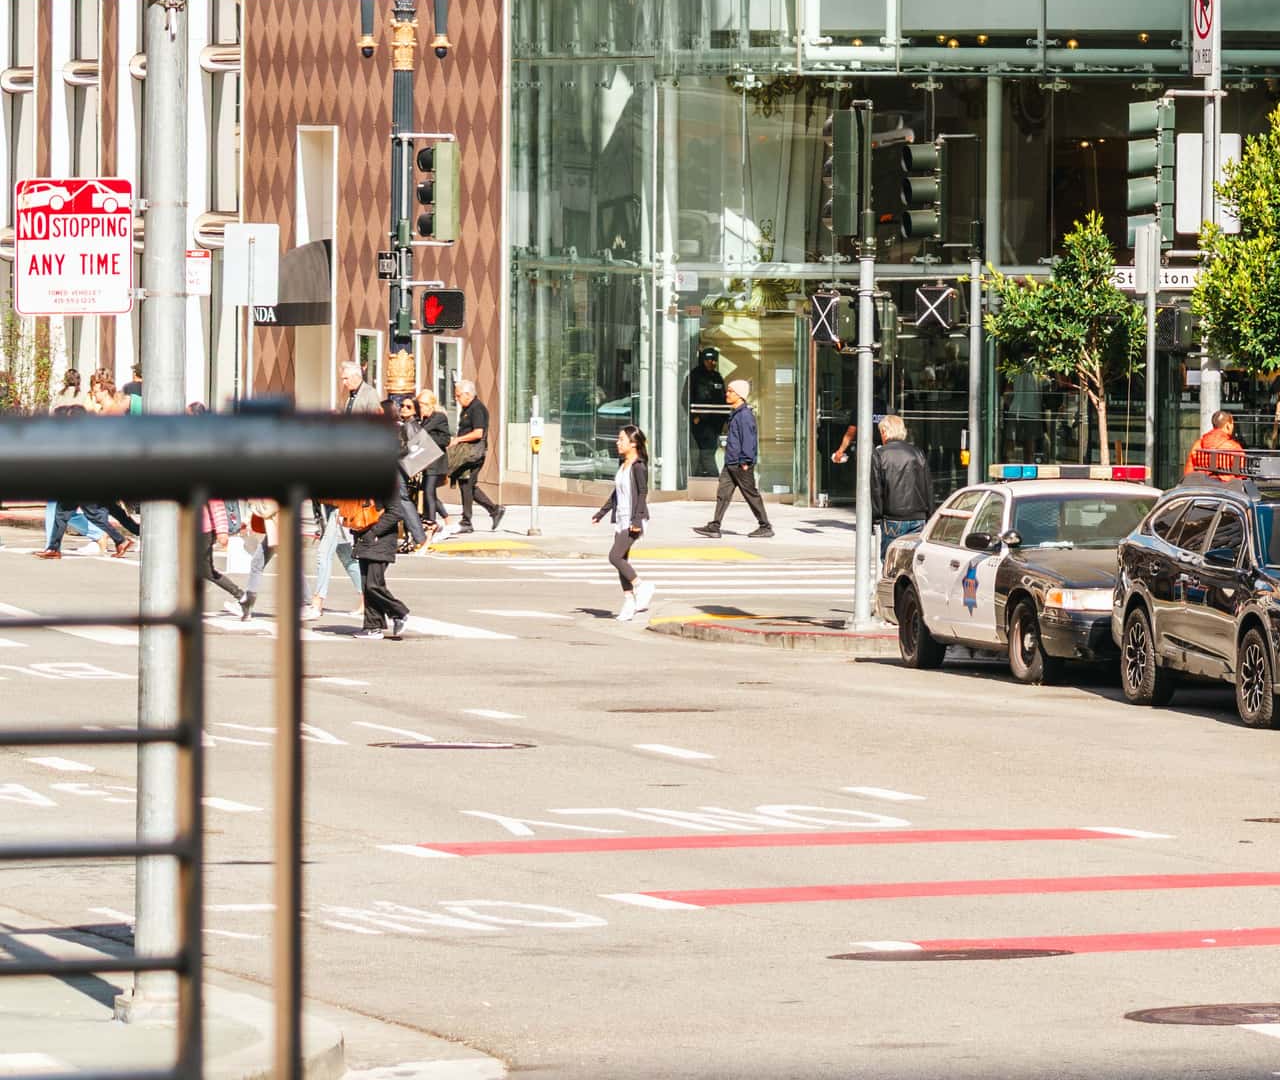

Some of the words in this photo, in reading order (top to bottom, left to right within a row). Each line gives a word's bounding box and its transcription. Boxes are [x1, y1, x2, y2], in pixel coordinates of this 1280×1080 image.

[19, 211, 48, 238] NO
[52, 217, 128, 238] STOPPING
[28, 253, 65, 276] ANY
[80, 253, 121, 275] TIME
[1117, 271, 1189, 284] Stton
